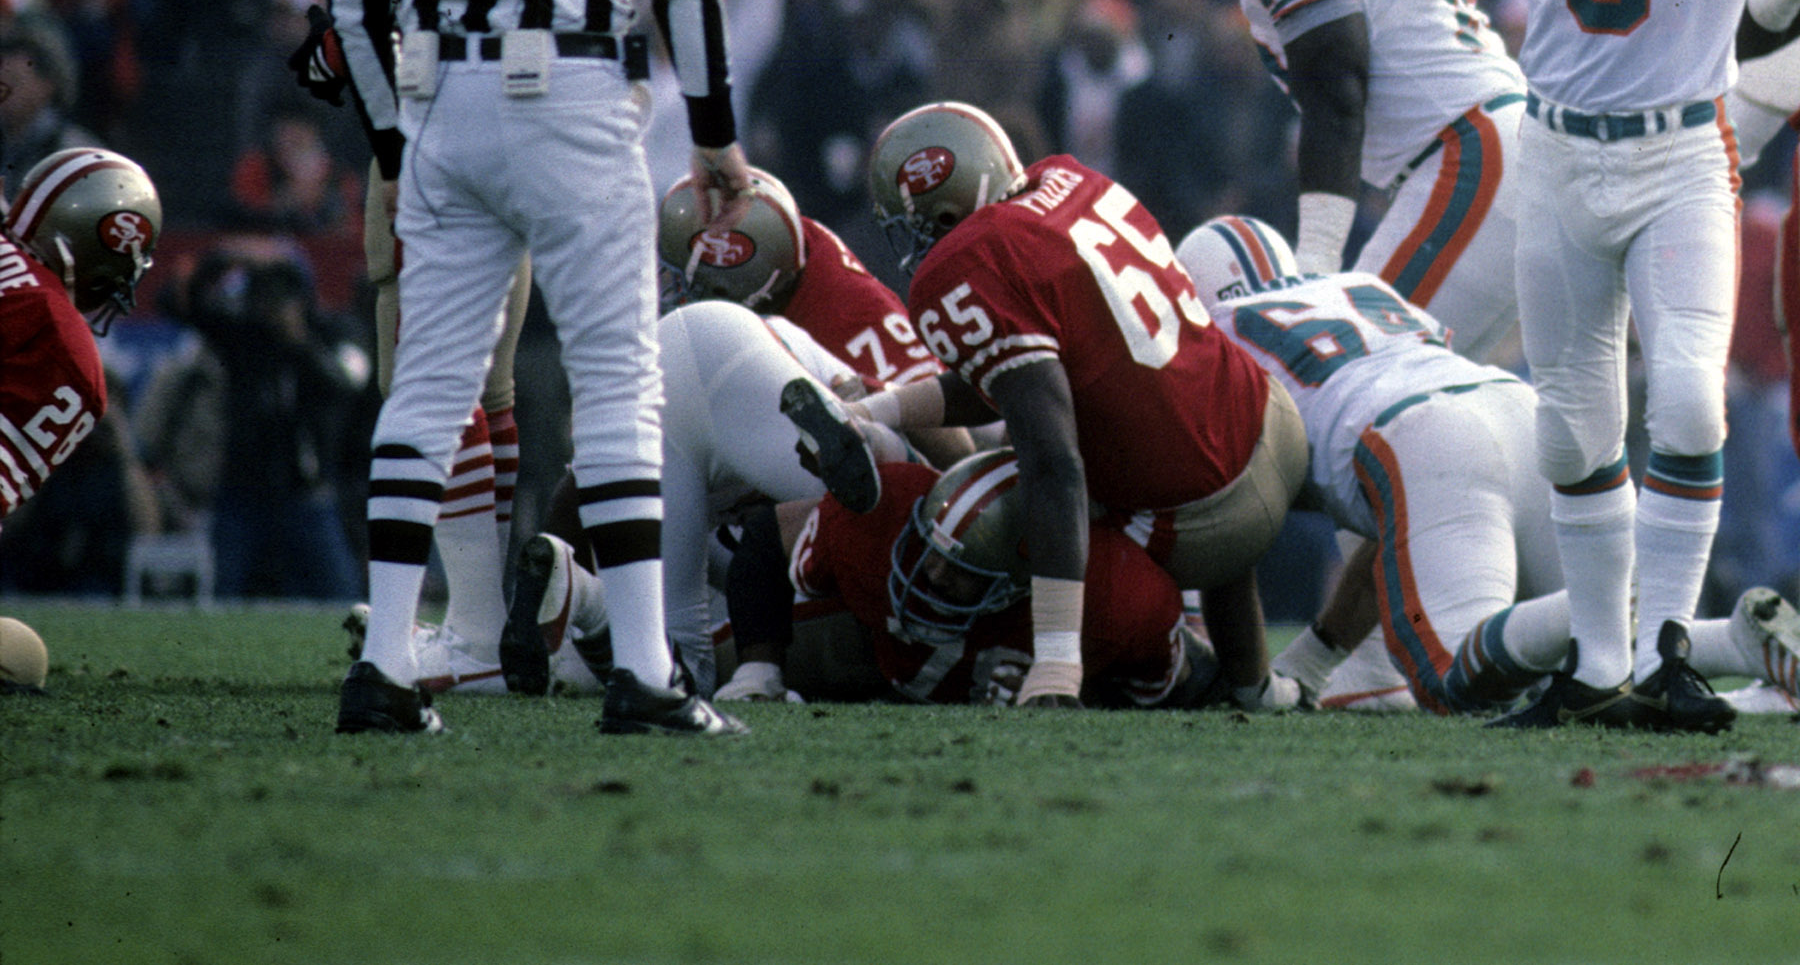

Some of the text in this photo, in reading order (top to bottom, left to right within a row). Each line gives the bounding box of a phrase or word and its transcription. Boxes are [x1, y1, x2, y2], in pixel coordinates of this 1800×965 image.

[1068, 182, 1211, 370] 65
[846, 312, 930, 382] 79
[919, 283, 993, 363] 65
[22, 386, 96, 465] 28
